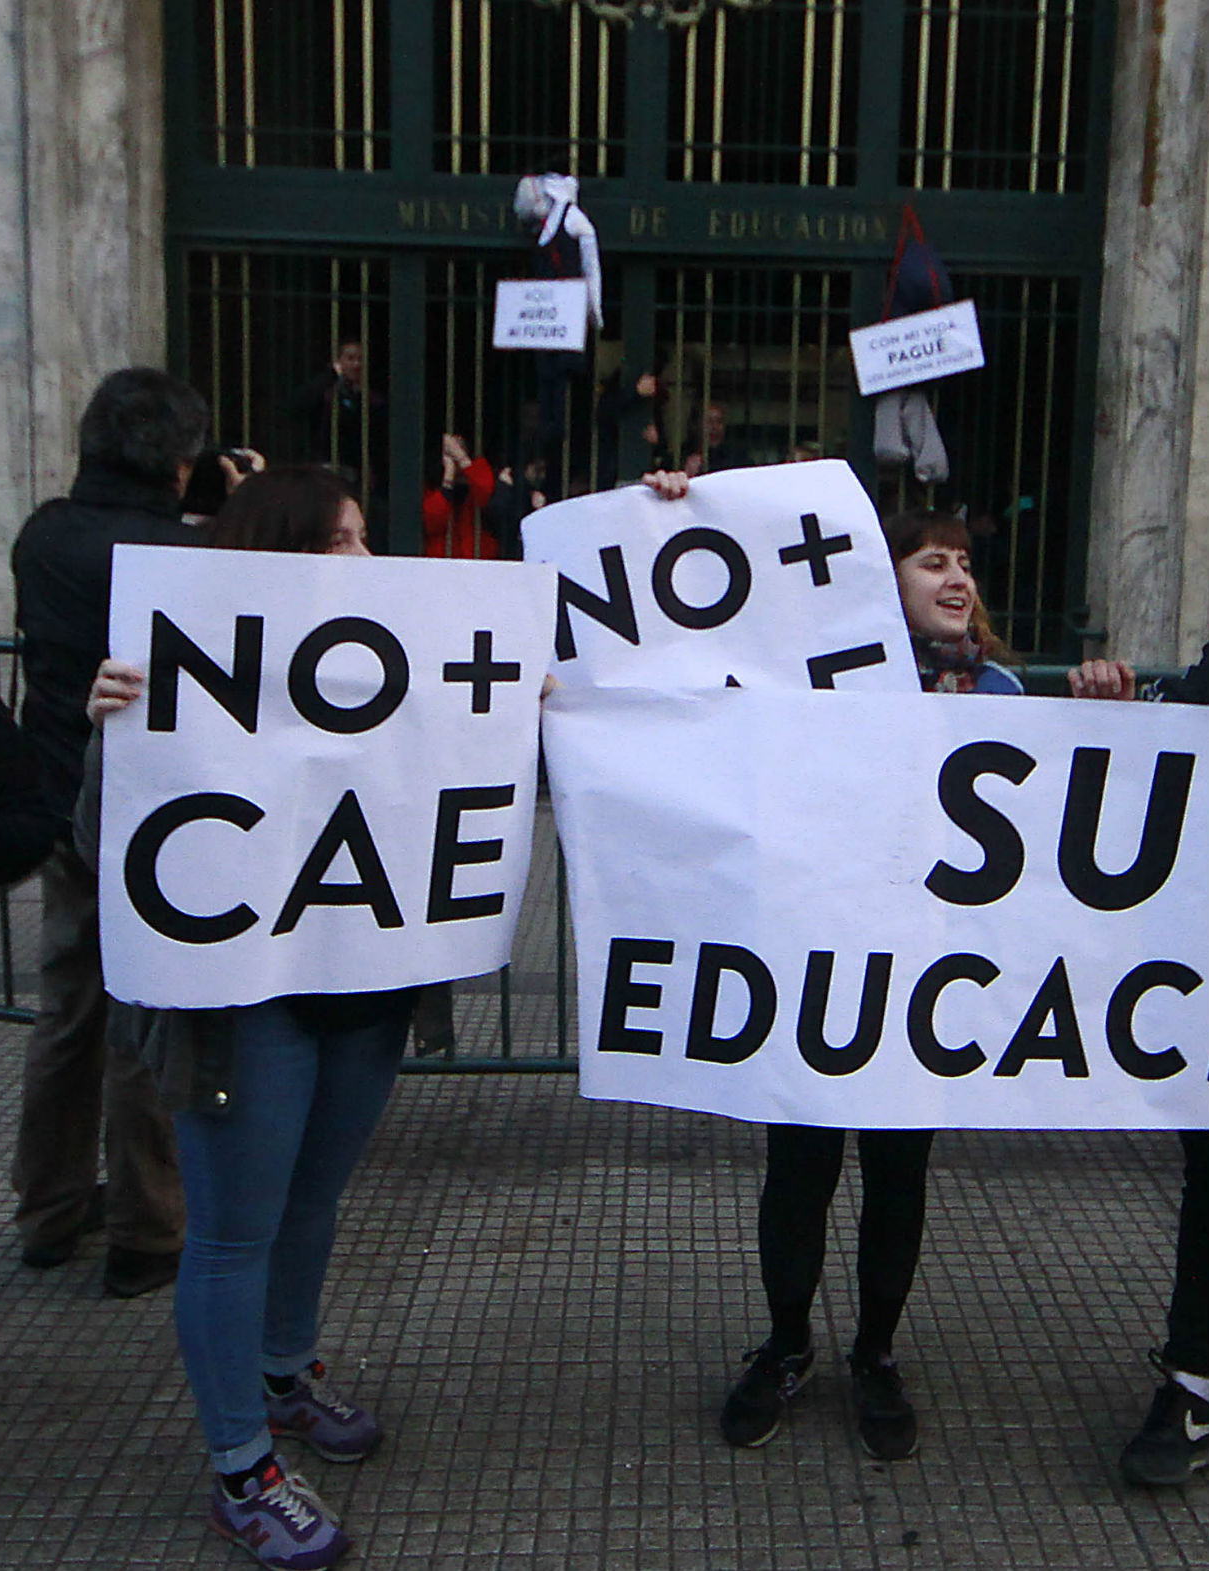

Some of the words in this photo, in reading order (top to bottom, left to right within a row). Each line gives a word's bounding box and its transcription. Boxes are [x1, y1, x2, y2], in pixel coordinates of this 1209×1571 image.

[630, 206, 668, 237] DE
[869, 336, 900, 350] CON
[124, 783, 516, 945] CAE
[924, 740, 1196, 912] SU
[597, 936, 1209, 1081] EDUCAC
